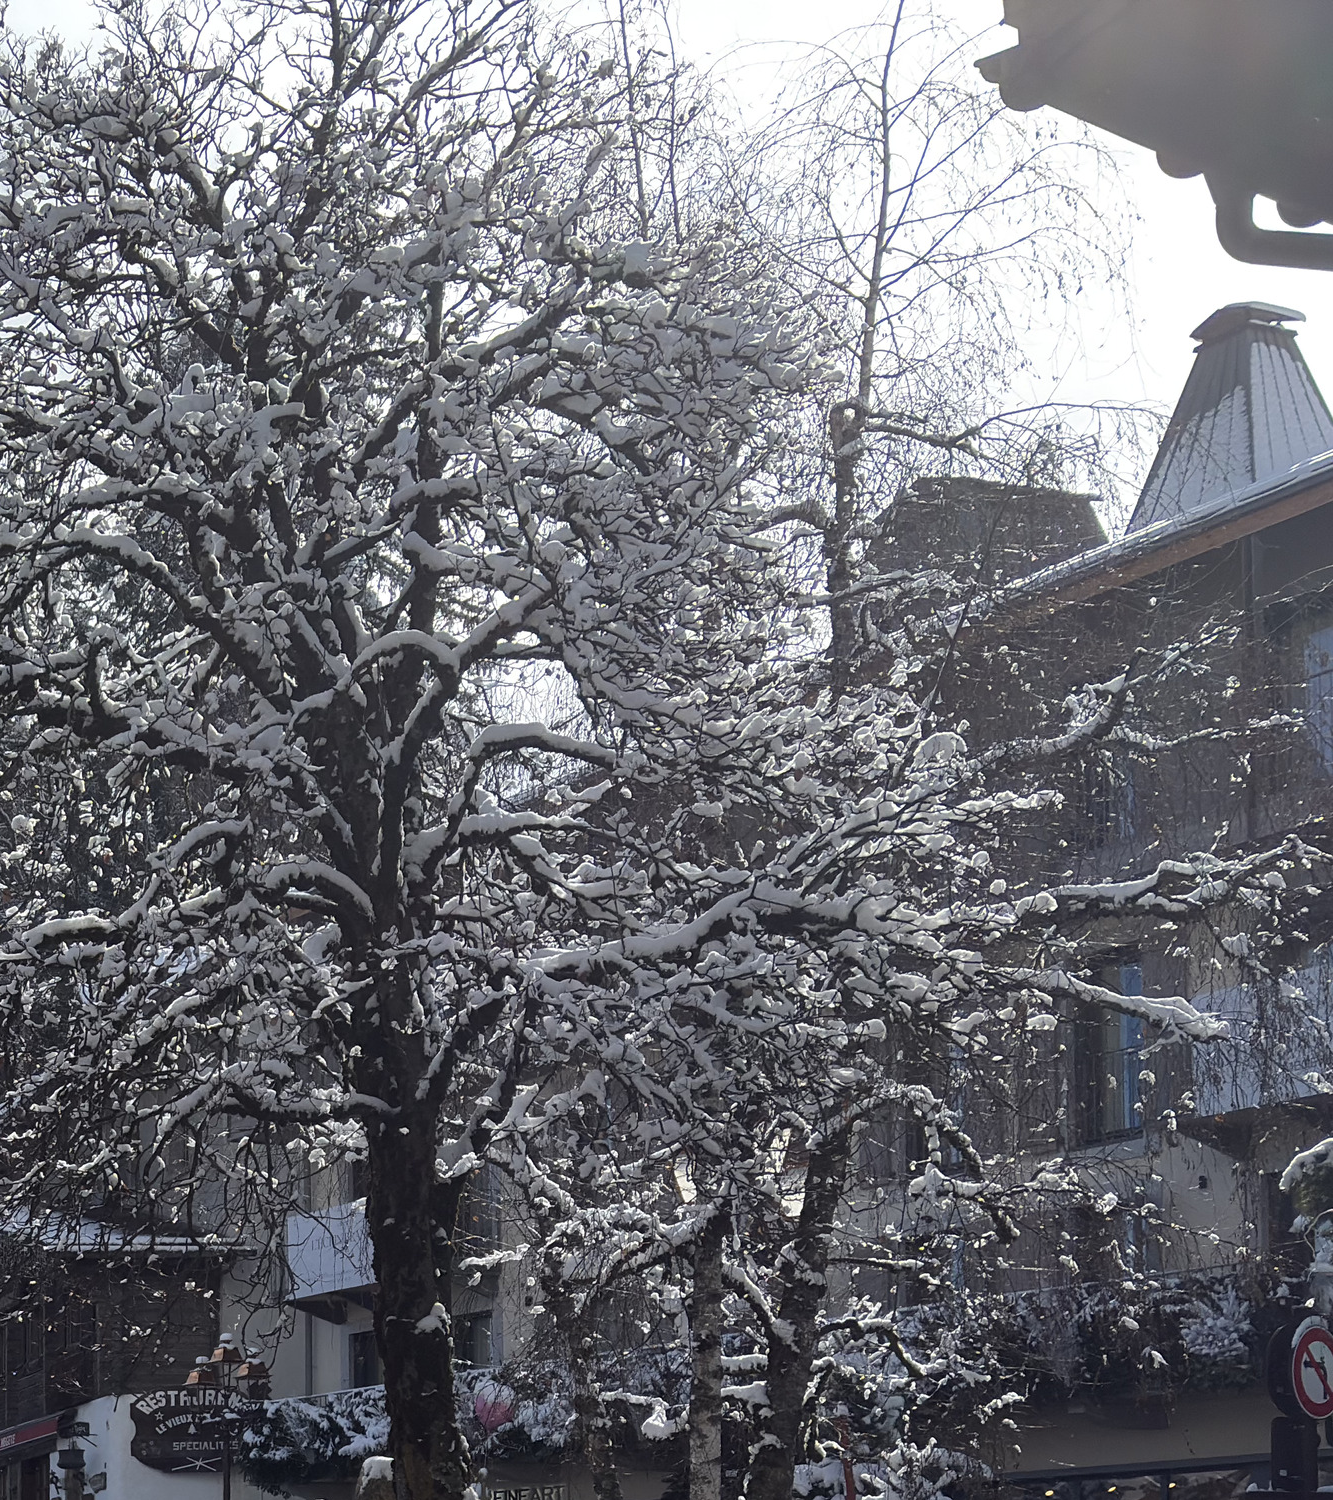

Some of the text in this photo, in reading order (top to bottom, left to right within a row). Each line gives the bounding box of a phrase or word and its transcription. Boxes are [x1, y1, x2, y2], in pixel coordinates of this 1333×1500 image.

[135, 1389, 244, 1415] RESTAURAN
[155, 1423, 167, 1435] LE
[165, 1413, 193, 1428] VIEUX
[173, 1441, 239, 1451] SPECIALITS
